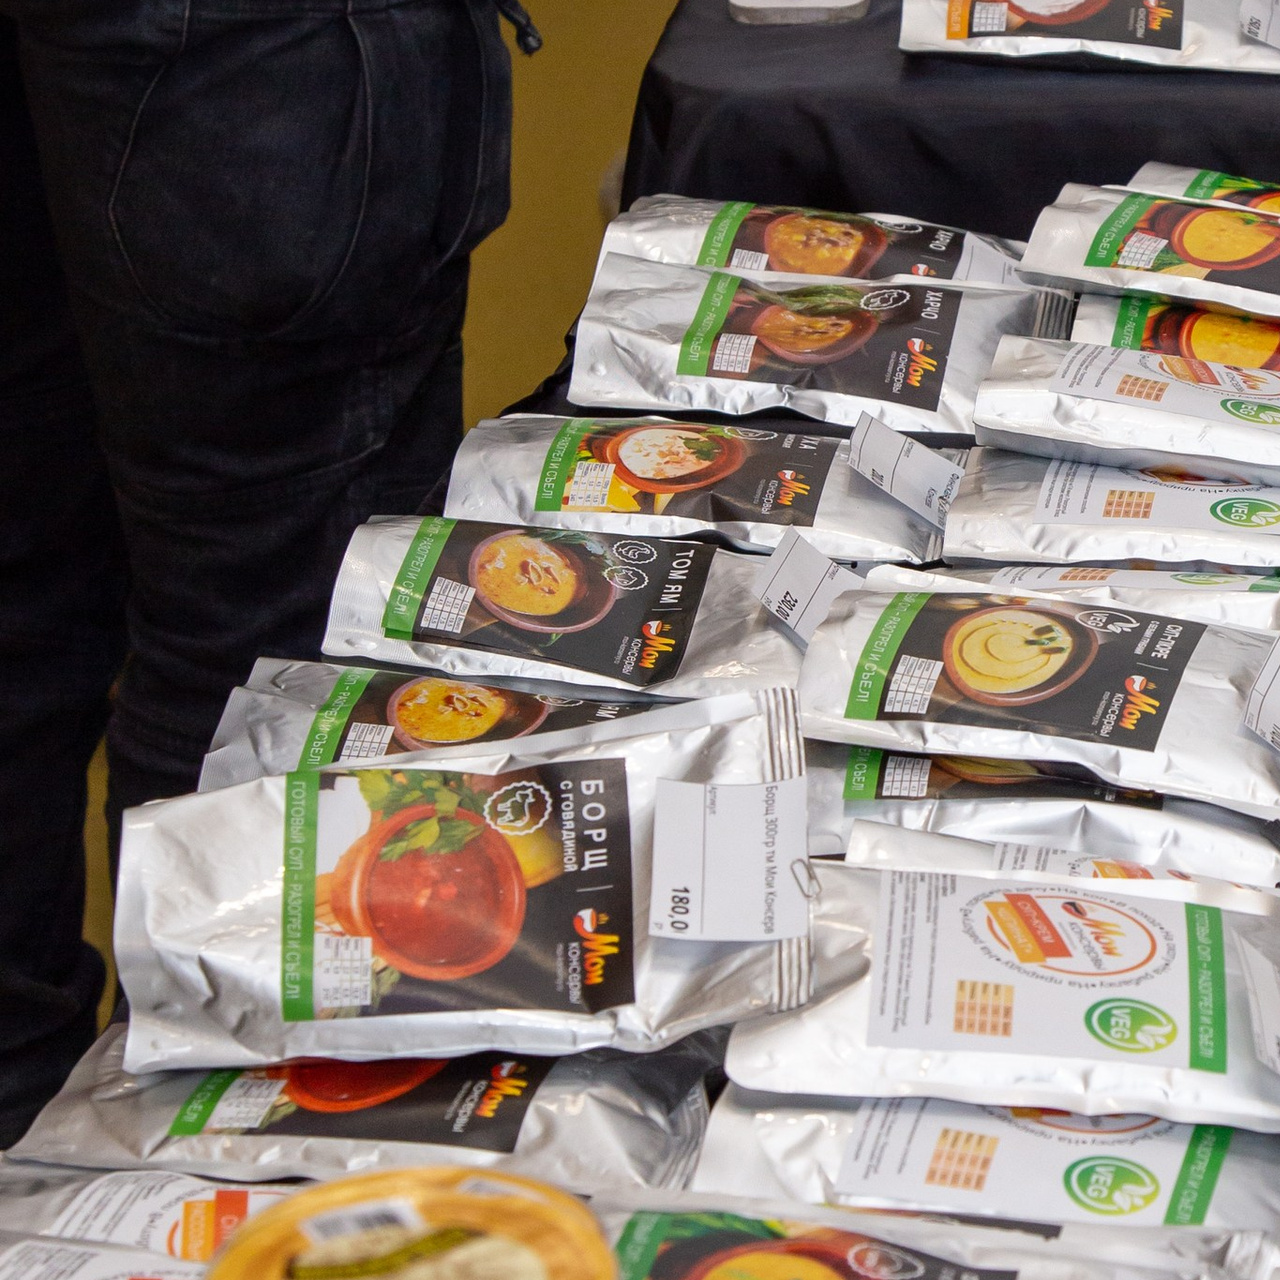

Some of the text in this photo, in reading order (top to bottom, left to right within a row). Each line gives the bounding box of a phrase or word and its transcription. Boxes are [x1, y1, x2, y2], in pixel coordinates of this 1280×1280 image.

[927, 229, 955, 251] ХАРЧО
[1095, 232, 1117, 258] СЪЕЛ!
[921, 290, 944, 320] ХАРЧО
[891, 353, 910, 393] консервы
[906, 350, 937, 387] Мои
[542, 471, 559, 499] СЪЕЛ!
[762, 479, 780, 514] консервы
[778, 474, 810, 505] Мои
[1231, 501, 1249, 520] VEG
[406, 539, 430, 572] РАЗОГРЕЛ
[659, 549, 695, 604] ТОМ ЯМ
[393, 582, 415, 615] СЪЕЛ!
[774, 590, 800, 620] 230,00
[1086, 611, 1108, 628] VEG
[622, 637, 642, 675] консервы
[639, 632, 676, 668] Мои
[1151, 625, 1183, 659] СУП-ПЮРЕ
[855, 619, 900, 702] РАЗОГРЕЛ СЪЕЛ!
[1099, 693, 1125, 737] консервы
[1119, 687, 1160, 729] Мои
[306, 734, 331, 765] СЪЕЛ!
[851, 763, 867, 791] СЪЕЛ!
[287, 781, 309, 843] ГОТОВЫЙ
[763, 785, 778, 815] Борщ
[560, 781, 578, 872] С ГОВЯДИНОЙ
[581, 780, 608, 871] БОРЩ
[762, 818, 778, 847] 300гр
[286, 845, 306, 870] СУП
[765, 851, 777, 862] тм
[765, 866, 777, 888] Мои
[1083, 917, 1125, 957] Мои
[567, 942, 581, 1004] консервы
[577, 927, 620, 985] Мои
[284, 952, 302, 1000] СЪЕЛ!
[1108, 1008, 1132, 1039] VEG
[451, 1080, 488, 1133] консервы
[474, 1077, 526, 1117] Мои
